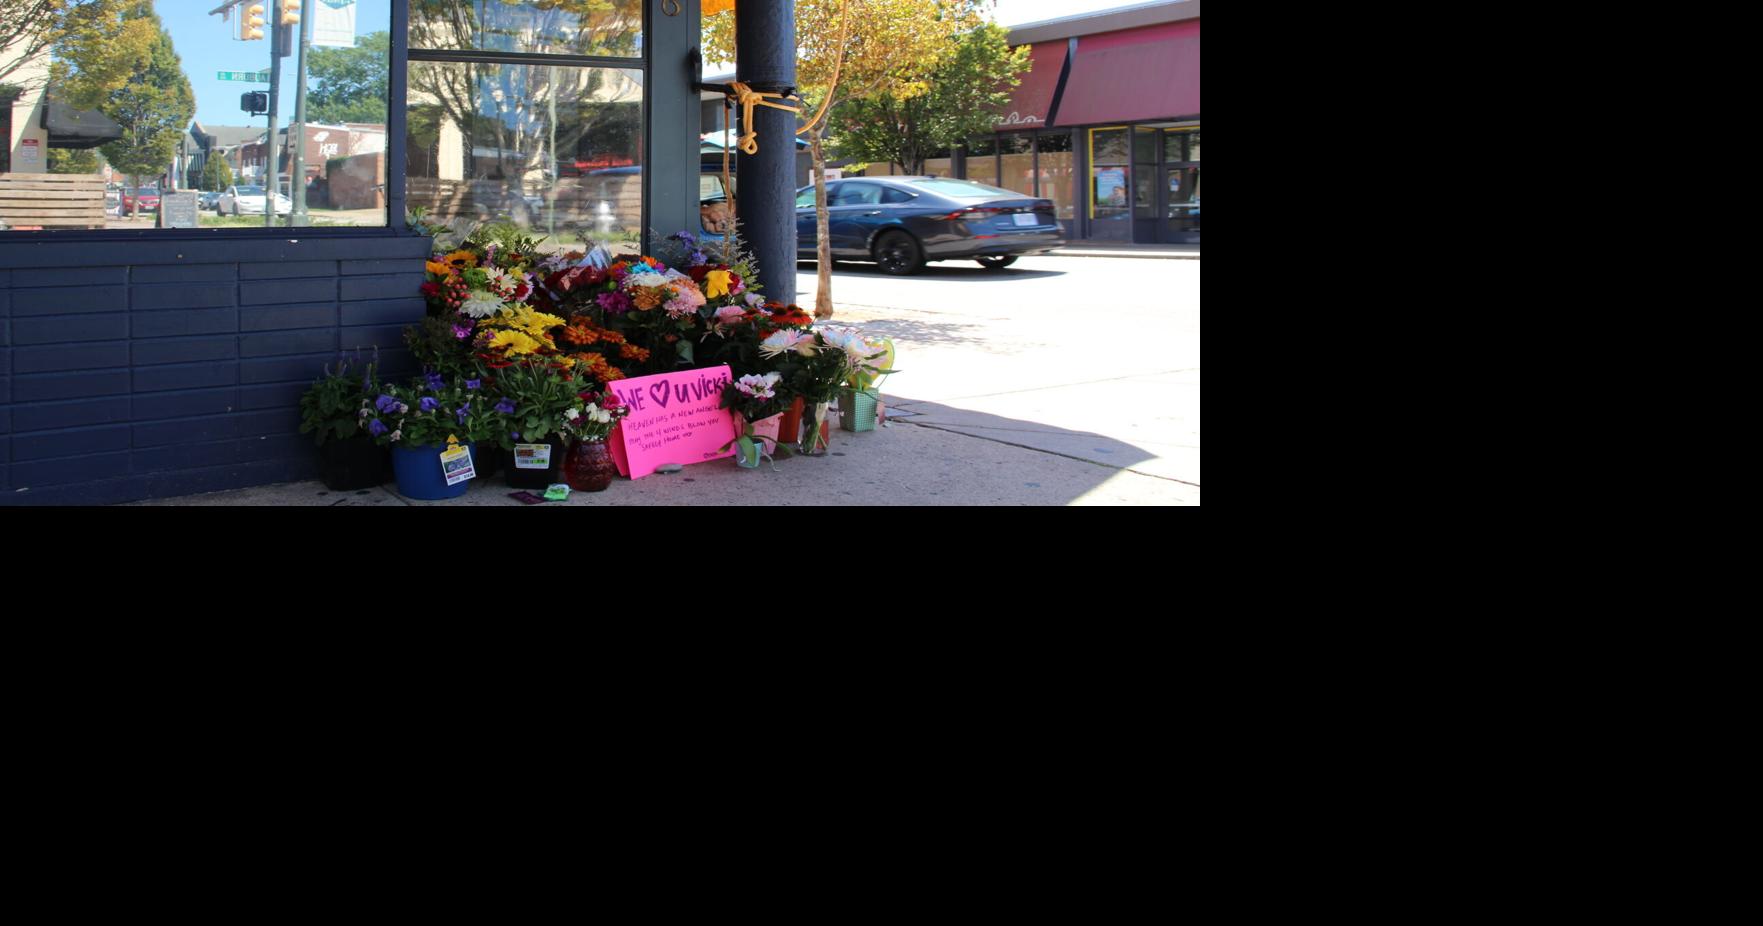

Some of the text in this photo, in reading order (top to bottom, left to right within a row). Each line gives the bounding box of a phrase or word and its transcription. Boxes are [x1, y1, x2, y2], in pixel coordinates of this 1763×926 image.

[616, 387, 646, 411] WE
[628, 417, 654, 431] HEAVEN
[678, 409, 694, 417] NEW
